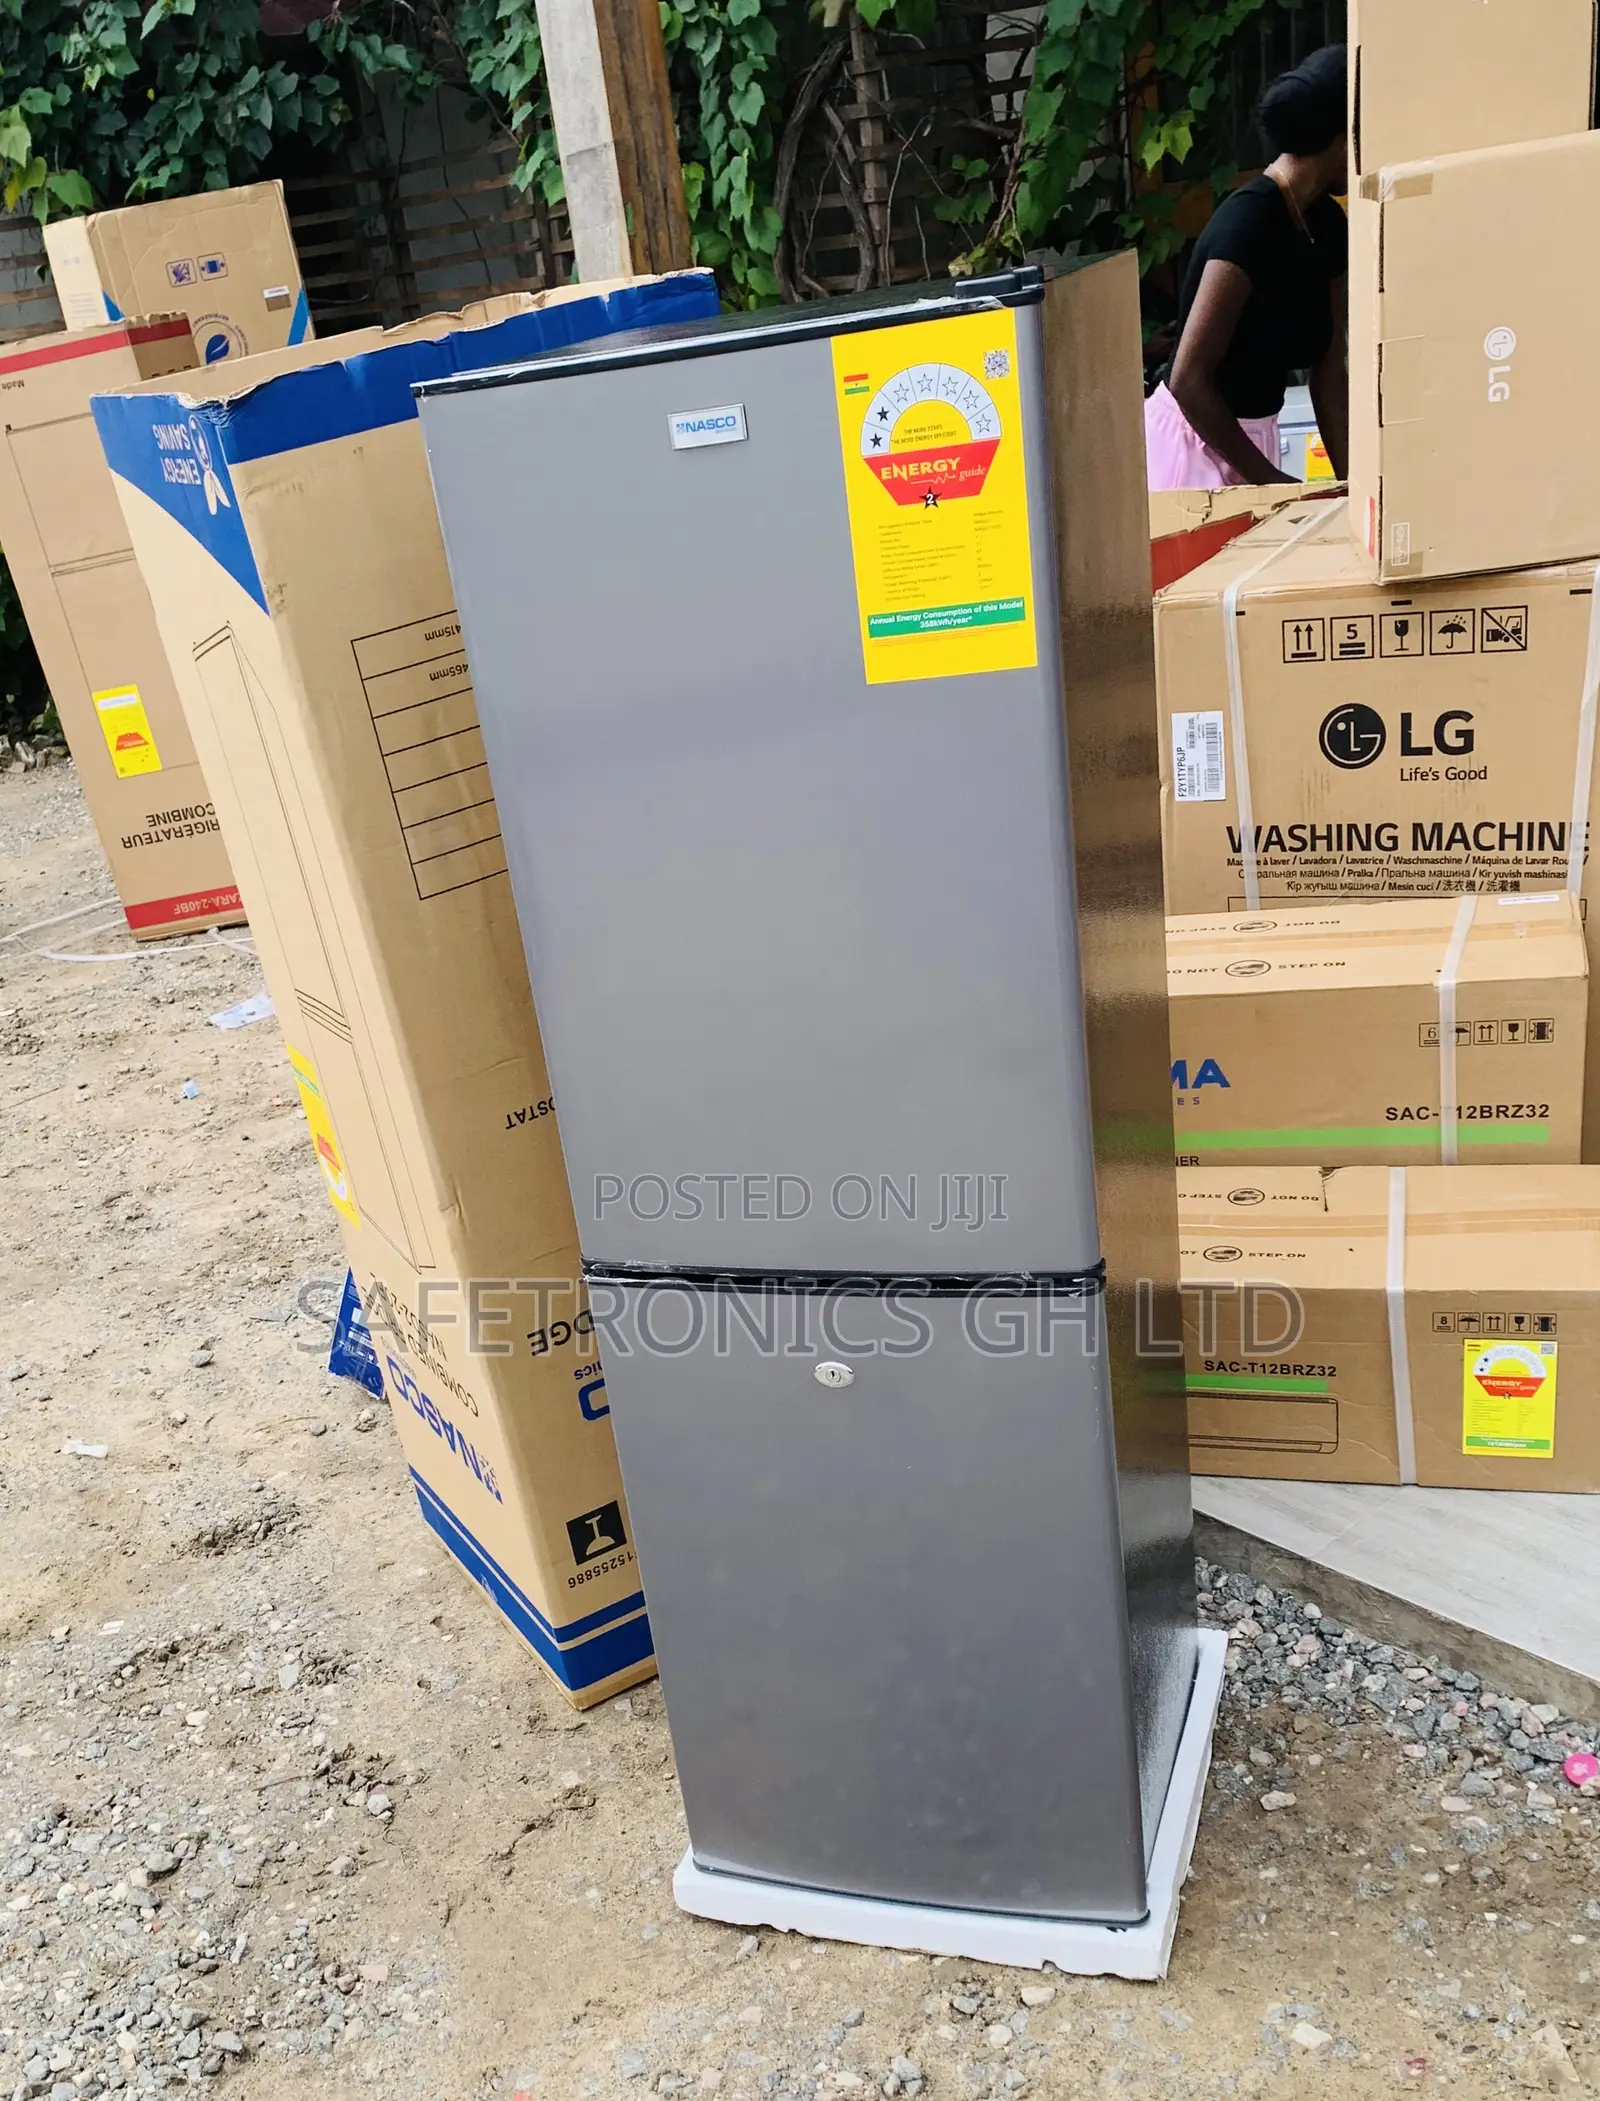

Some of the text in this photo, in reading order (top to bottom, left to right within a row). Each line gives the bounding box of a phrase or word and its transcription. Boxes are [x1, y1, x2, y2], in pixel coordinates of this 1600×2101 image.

[1, 379, 25, 392] Made
[1487, 365, 1511, 403] LG
[685, 415, 737, 433] NASCO
[152, 423, 191, 450] SAVING
[160, 457, 202, 485] ENERGY
[880, 457, 986, 482] ENERGY guide
[926, 493, 935, 504] 2
[869, 600, 1024, 625] Annual Energy Consumption of this Model
[1345, 623, 1358, 641] 5
[1400, 709, 1475, 756] LG
[1400, 766, 1488, 782] Life's Good
[145, 803, 216, 828] COMBINE
[1226, 823, 1399, 853] WASHING
[1269, 857, 1291, 866] laver
[1299, 856, 1338, 866] Lavadora
[1345, 856, 1385, 865] Lavatrice
[1393, 856, 1463, 866] Waschmaschine
[1472, 856, 1510, 867] Máquina
[1512, 856, 1523, 865] de
[1525, 857, 1550, 865] Lavar
[1300, 870, 1339, 878] машина
[1347, 869, 1374, 878] Pralka
[1382, 869, 1471, 880] Пральна машина
[1479, 870, 1491, 878] Kir
[1493, 869, 1522, 880] yuvish
[1340, 882, 1380, 890] машина
[1388, 882, 1414, 891] Mesin
[1416, 882, 1434, 891] cuci
[1443, 880, 1476, 892] 洗衣機
[1486, 880, 1521, 892] 洗濯機
[1427, 1027, 1437, 1039] 6
[1385, 1104, 1550, 1121] SAC-12BRZ32
[1440, 1316, 1448, 1325] 8
[407, 1334, 479, 1418] COMBINED
[1204, 1360, 1337, 1378] SAC-T12BRZ32
[386, 1355, 483, 1483] NASCO
